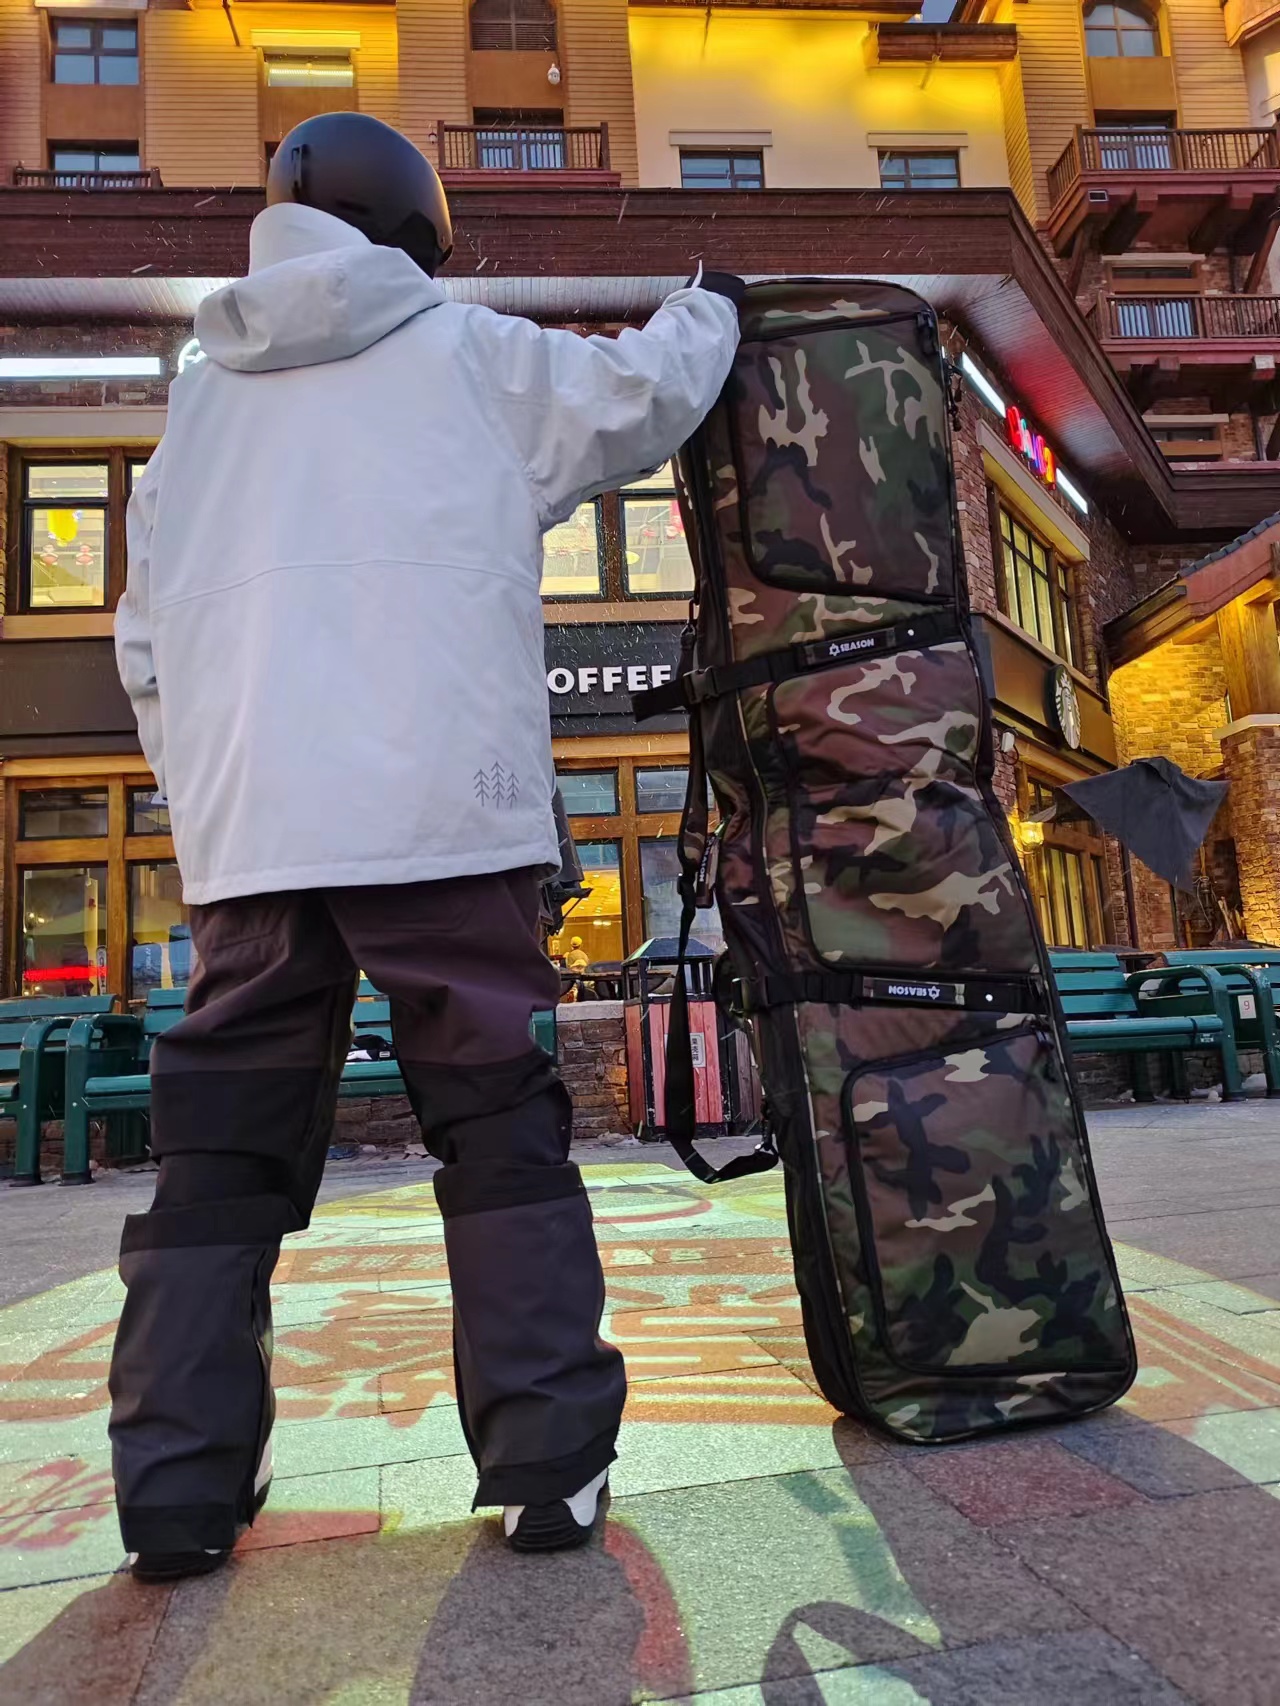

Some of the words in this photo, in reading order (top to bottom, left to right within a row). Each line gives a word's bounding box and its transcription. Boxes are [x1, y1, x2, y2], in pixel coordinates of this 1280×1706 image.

[840, 638, 875, 652] SEASON
[888, 985, 927, 997] SEASON
[1243, 1000, 1251, 1011] 9
